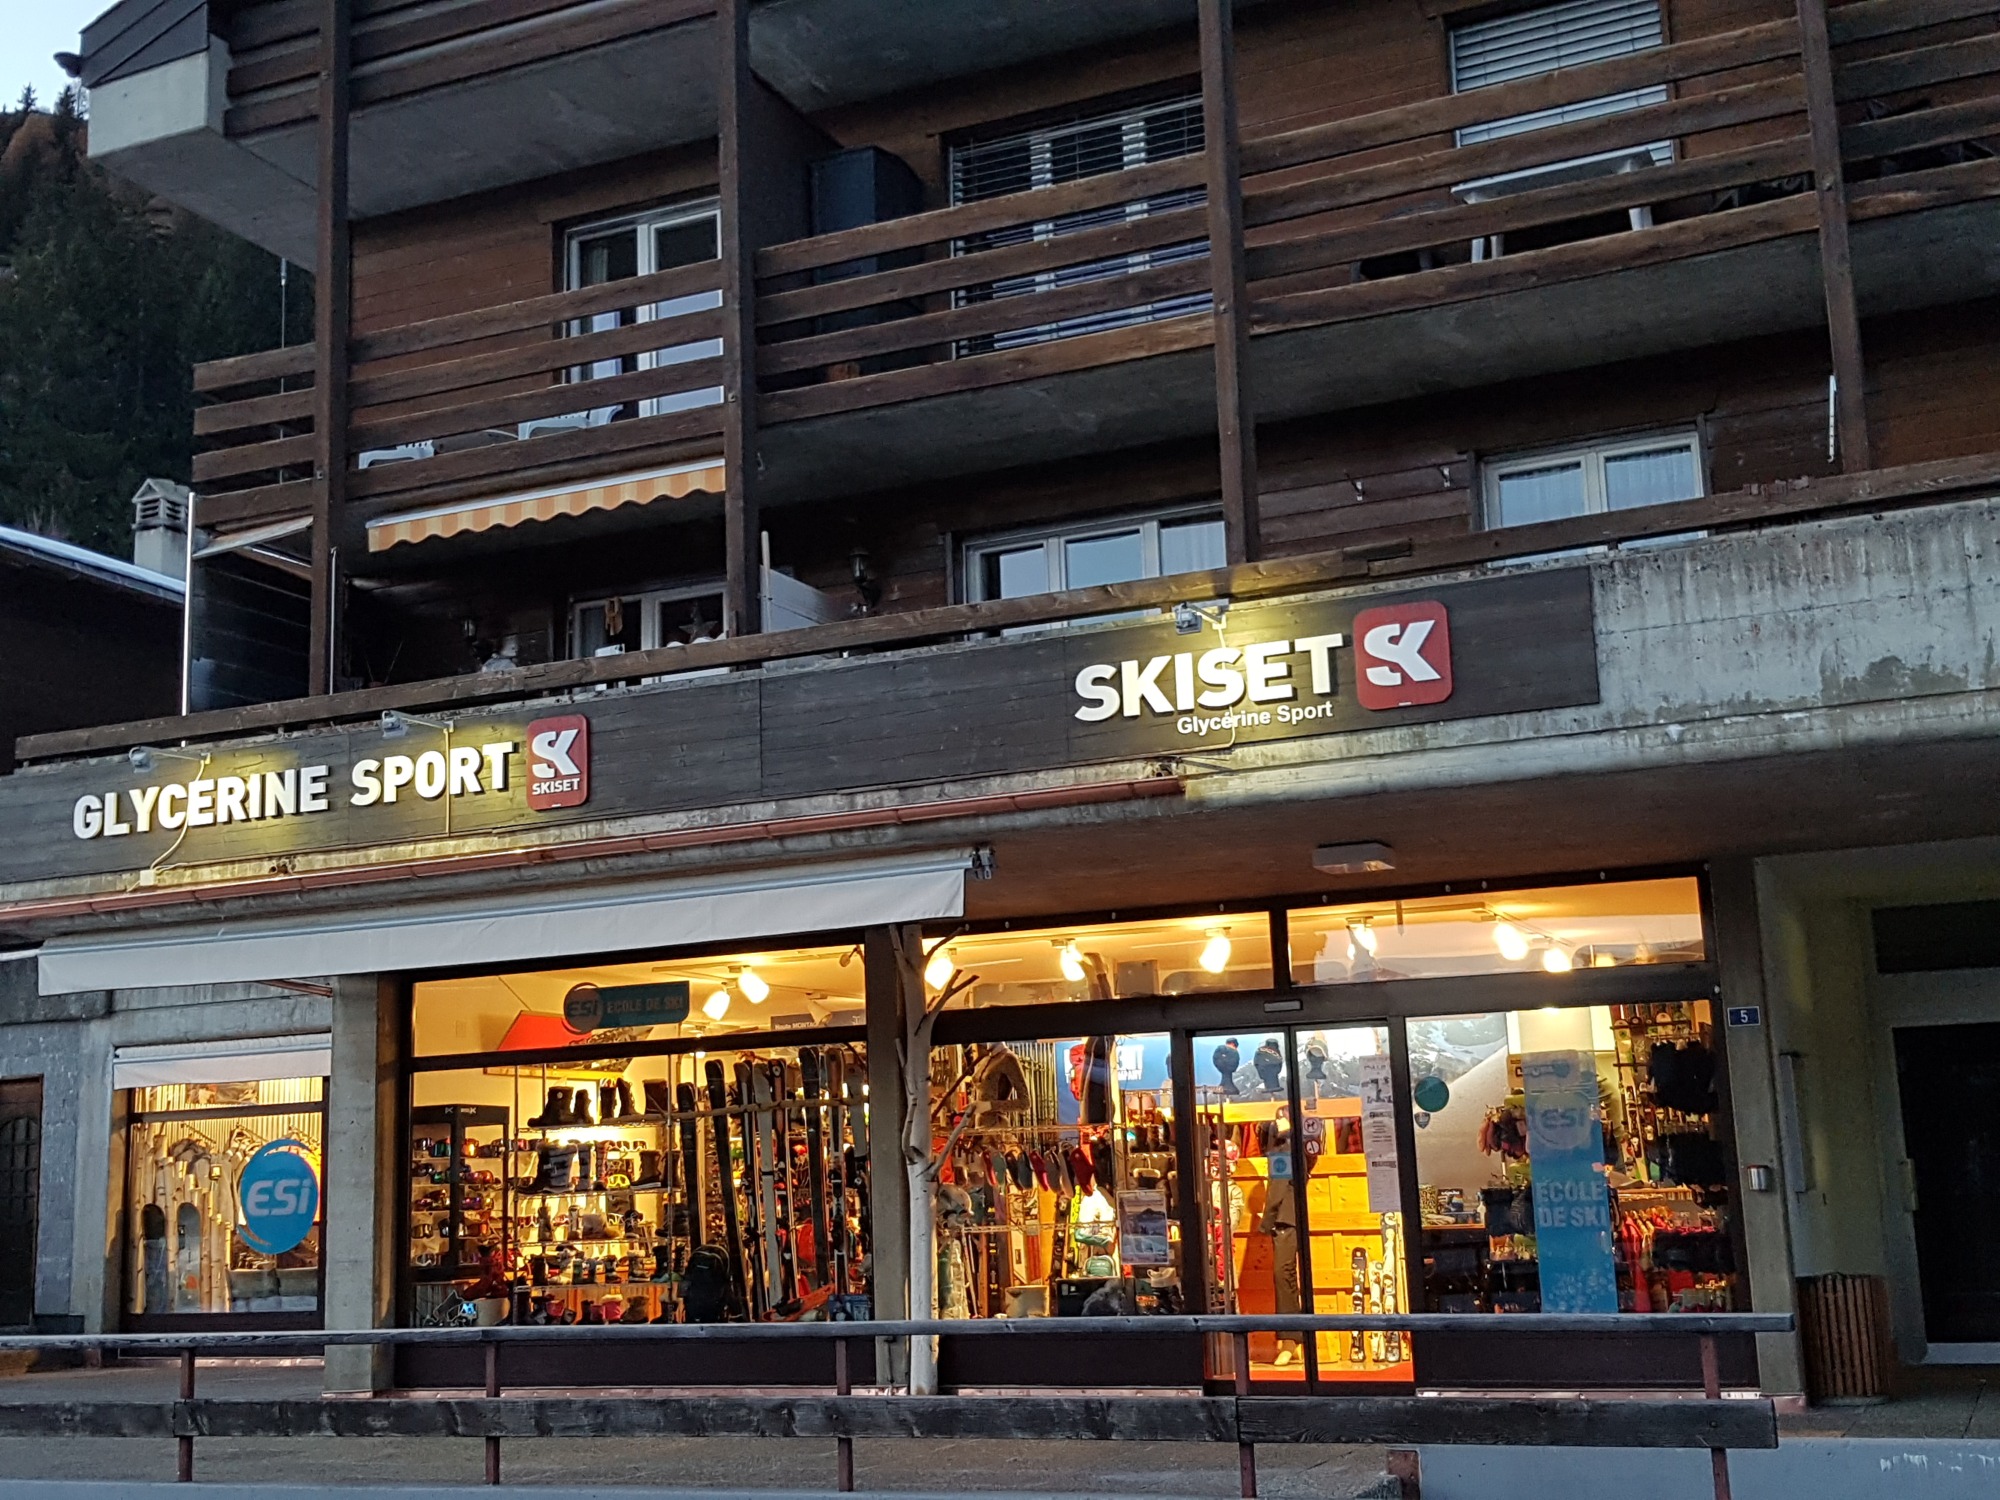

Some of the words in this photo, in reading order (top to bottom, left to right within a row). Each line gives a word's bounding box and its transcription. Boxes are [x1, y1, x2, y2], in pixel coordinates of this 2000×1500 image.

[1075, 633, 1343, 722] SKISET
[1177, 710, 1271, 736] Glycérine
[1277, 701, 1333, 725] Sport
[74, 765, 329, 839] GLYCERINE
[351, 742, 516, 807] SPORT
[532, 778, 580, 796] SKISET
[646, 998, 660, 1011] DE
[663, 995, 683, 1010] SKI
[1740, 1009, 1749, 1023] 5
[1538, 1206, 1566, 1227] DE
[1570, 1205, 1607, 1227] SKI
